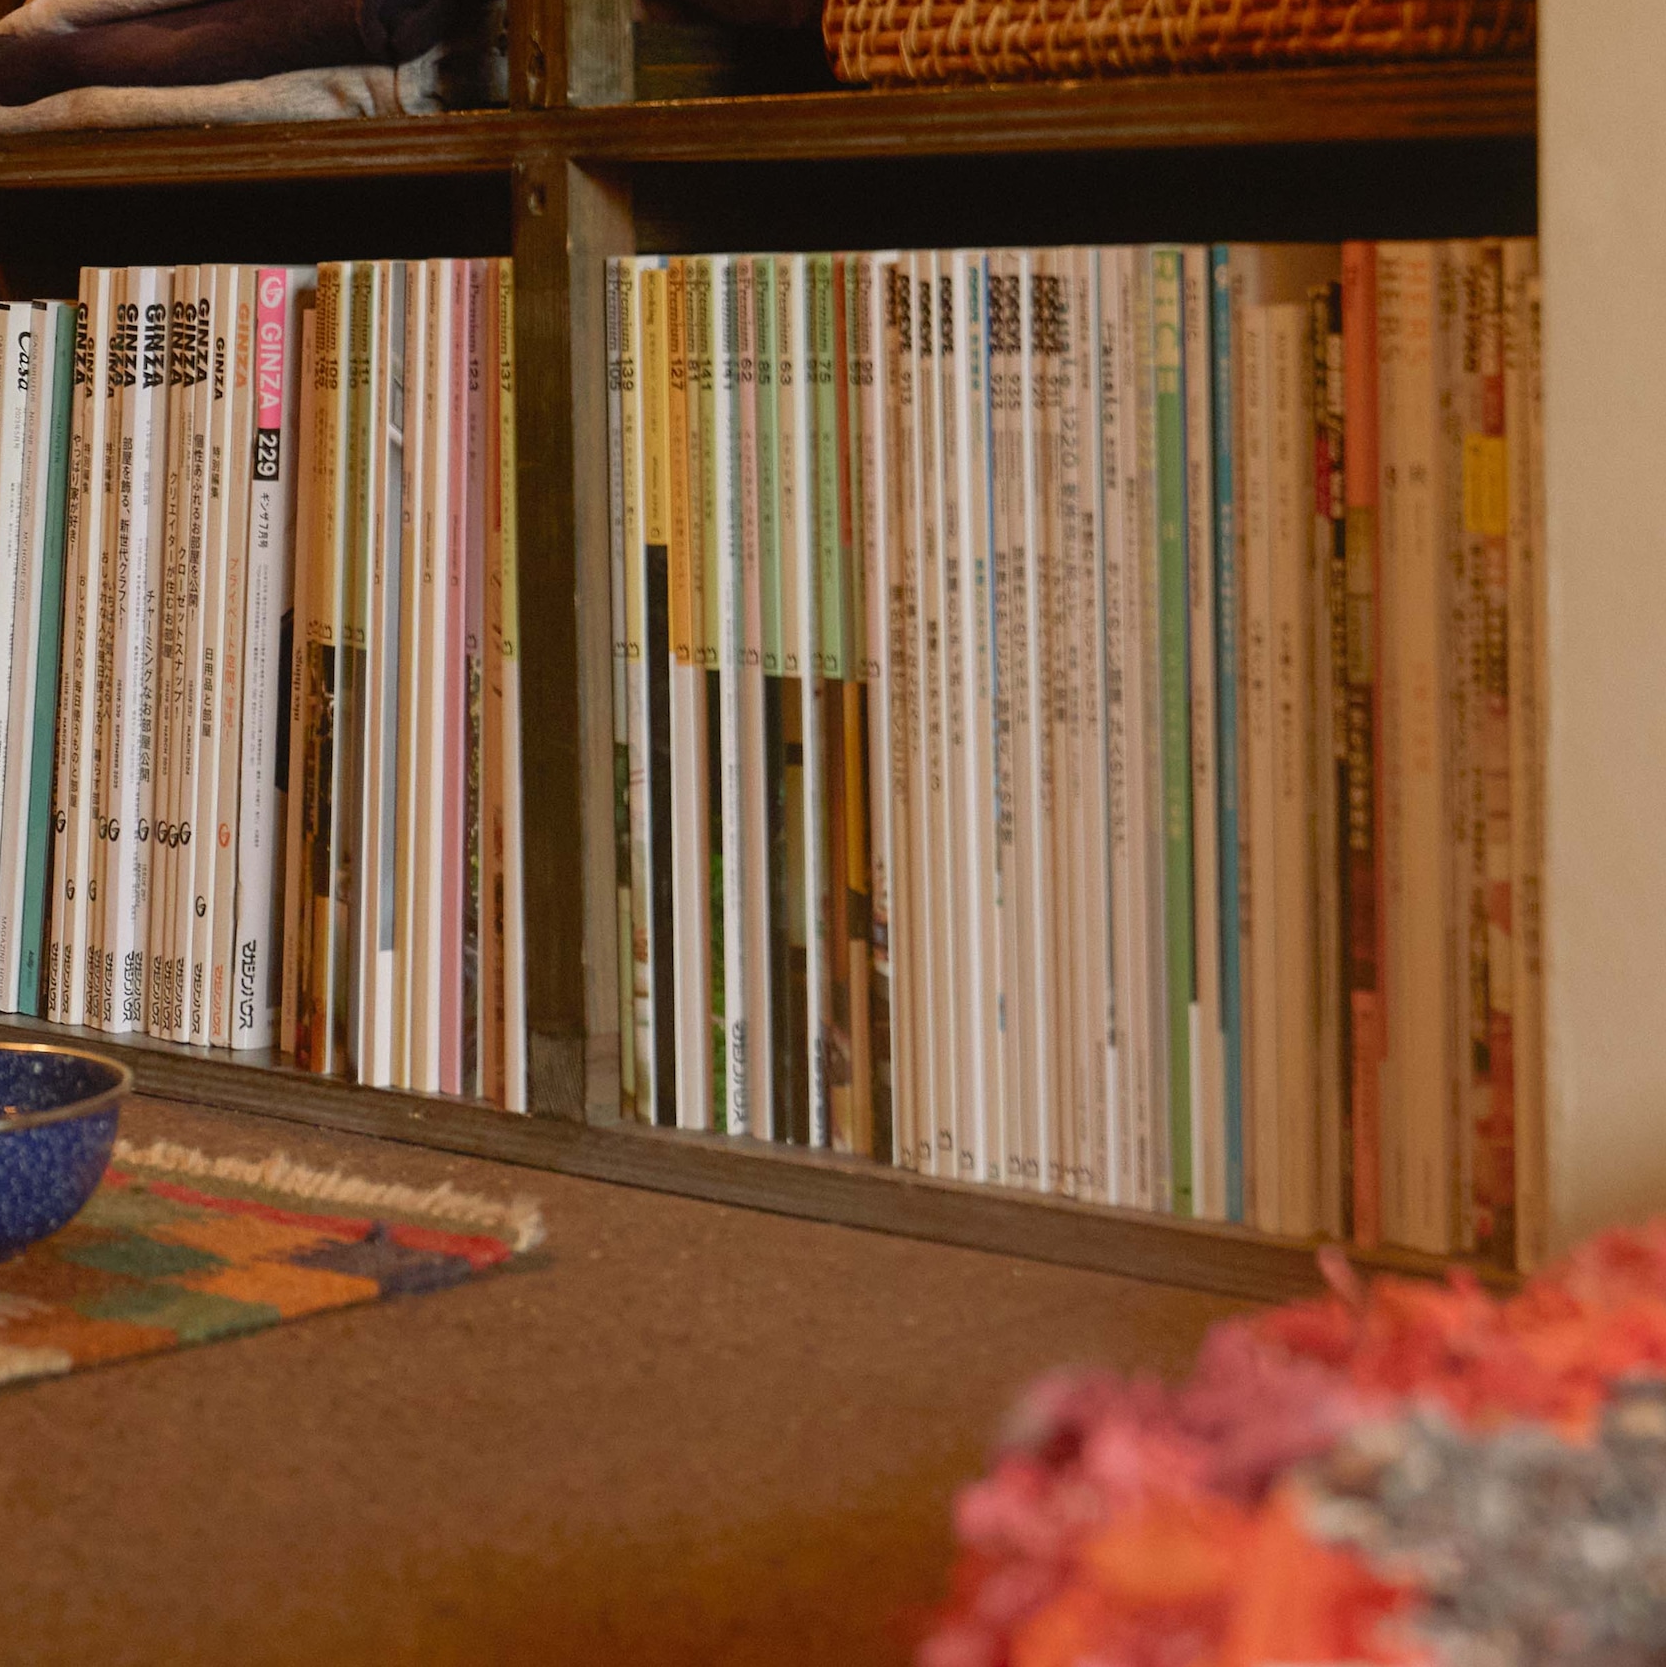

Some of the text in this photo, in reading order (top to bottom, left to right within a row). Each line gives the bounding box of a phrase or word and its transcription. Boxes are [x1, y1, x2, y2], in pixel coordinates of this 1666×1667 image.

[17, 331, 31, 392] Casa
[31, 334, 39, 362] CASA
[75, 302, 89, 385] GINZA
[123, 303, 139, 388] GINZA
[142, 304, 156, 390] GINZA
[153, 303, 166, 388] GINZA
[171, 301, 184, 387] GINZA
[183, 303, 197, 388] GINZA
[195, 298, 210, 384] GINZA
[236, 302, 250, 389] GINZA
[29, 363, 38, 404] BRUTUS
[85, 337, 95, 399] GINZA
[214, 337, 225, 401] GINZA
[260, 322, 283, 409] GINZA
[468, 359, 479, 392] 123
[500, 359, 512, 393] 137
[621, 357, 635, 391] 139
[670, 358, 684, 391] 127
[700, 359, 712, 391] 141
[740, 357, 753, 383] 62
[758, 360, 771, 385] 85
[779, 360, 792, 386] 63
[819, 359, 832, 384] 75
[257, 433, 279, 477] 229
[20, 548, 28, 577] HOME
[115, 679, 123, 702] ISSUE
[201, 647, 214, 739] 日用品と部屋
[293, 692, 301, 722] nice
[113, 724, 121, 769] SEPTEMBER
[185, 725, 193, 755] MARCH
[191, 962, 203, 1035] マガジンハウス
[238, 939, 257, 1031] マガジンハウス
